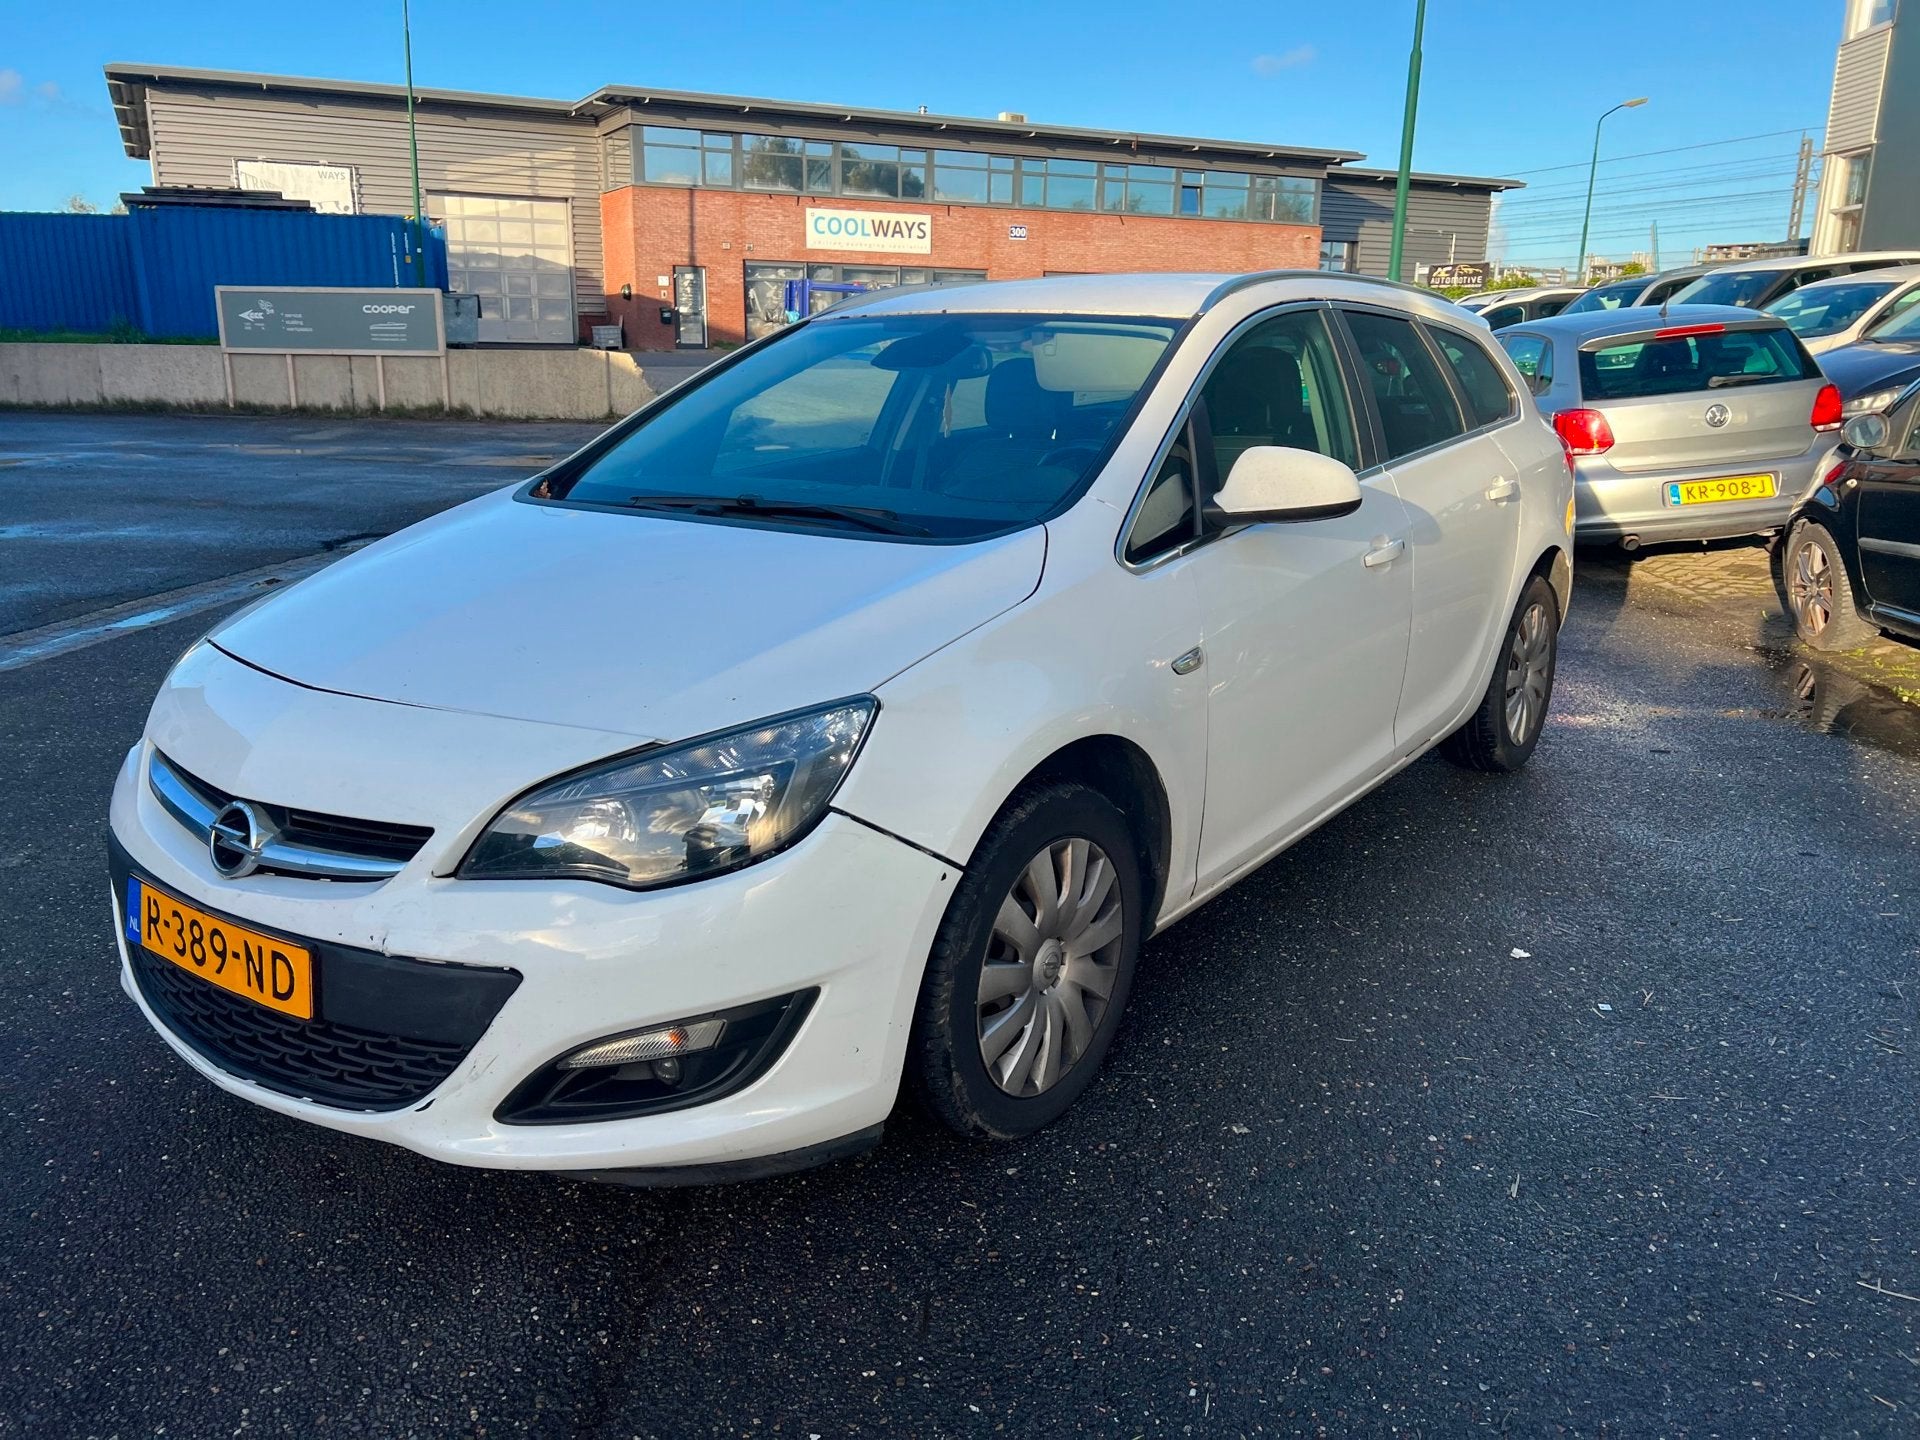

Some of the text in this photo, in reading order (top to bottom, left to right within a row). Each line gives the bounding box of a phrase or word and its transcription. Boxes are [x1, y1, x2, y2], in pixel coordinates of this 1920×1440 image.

[814, 216, 927, 239] COOLWAYS
[1010, 226, 1026, 237] 300
[1686, 480, 1766, 500] KR-908-J
[129, 915, 140, 933] NL
[147, 895, 295, 1001] R-389-ND
